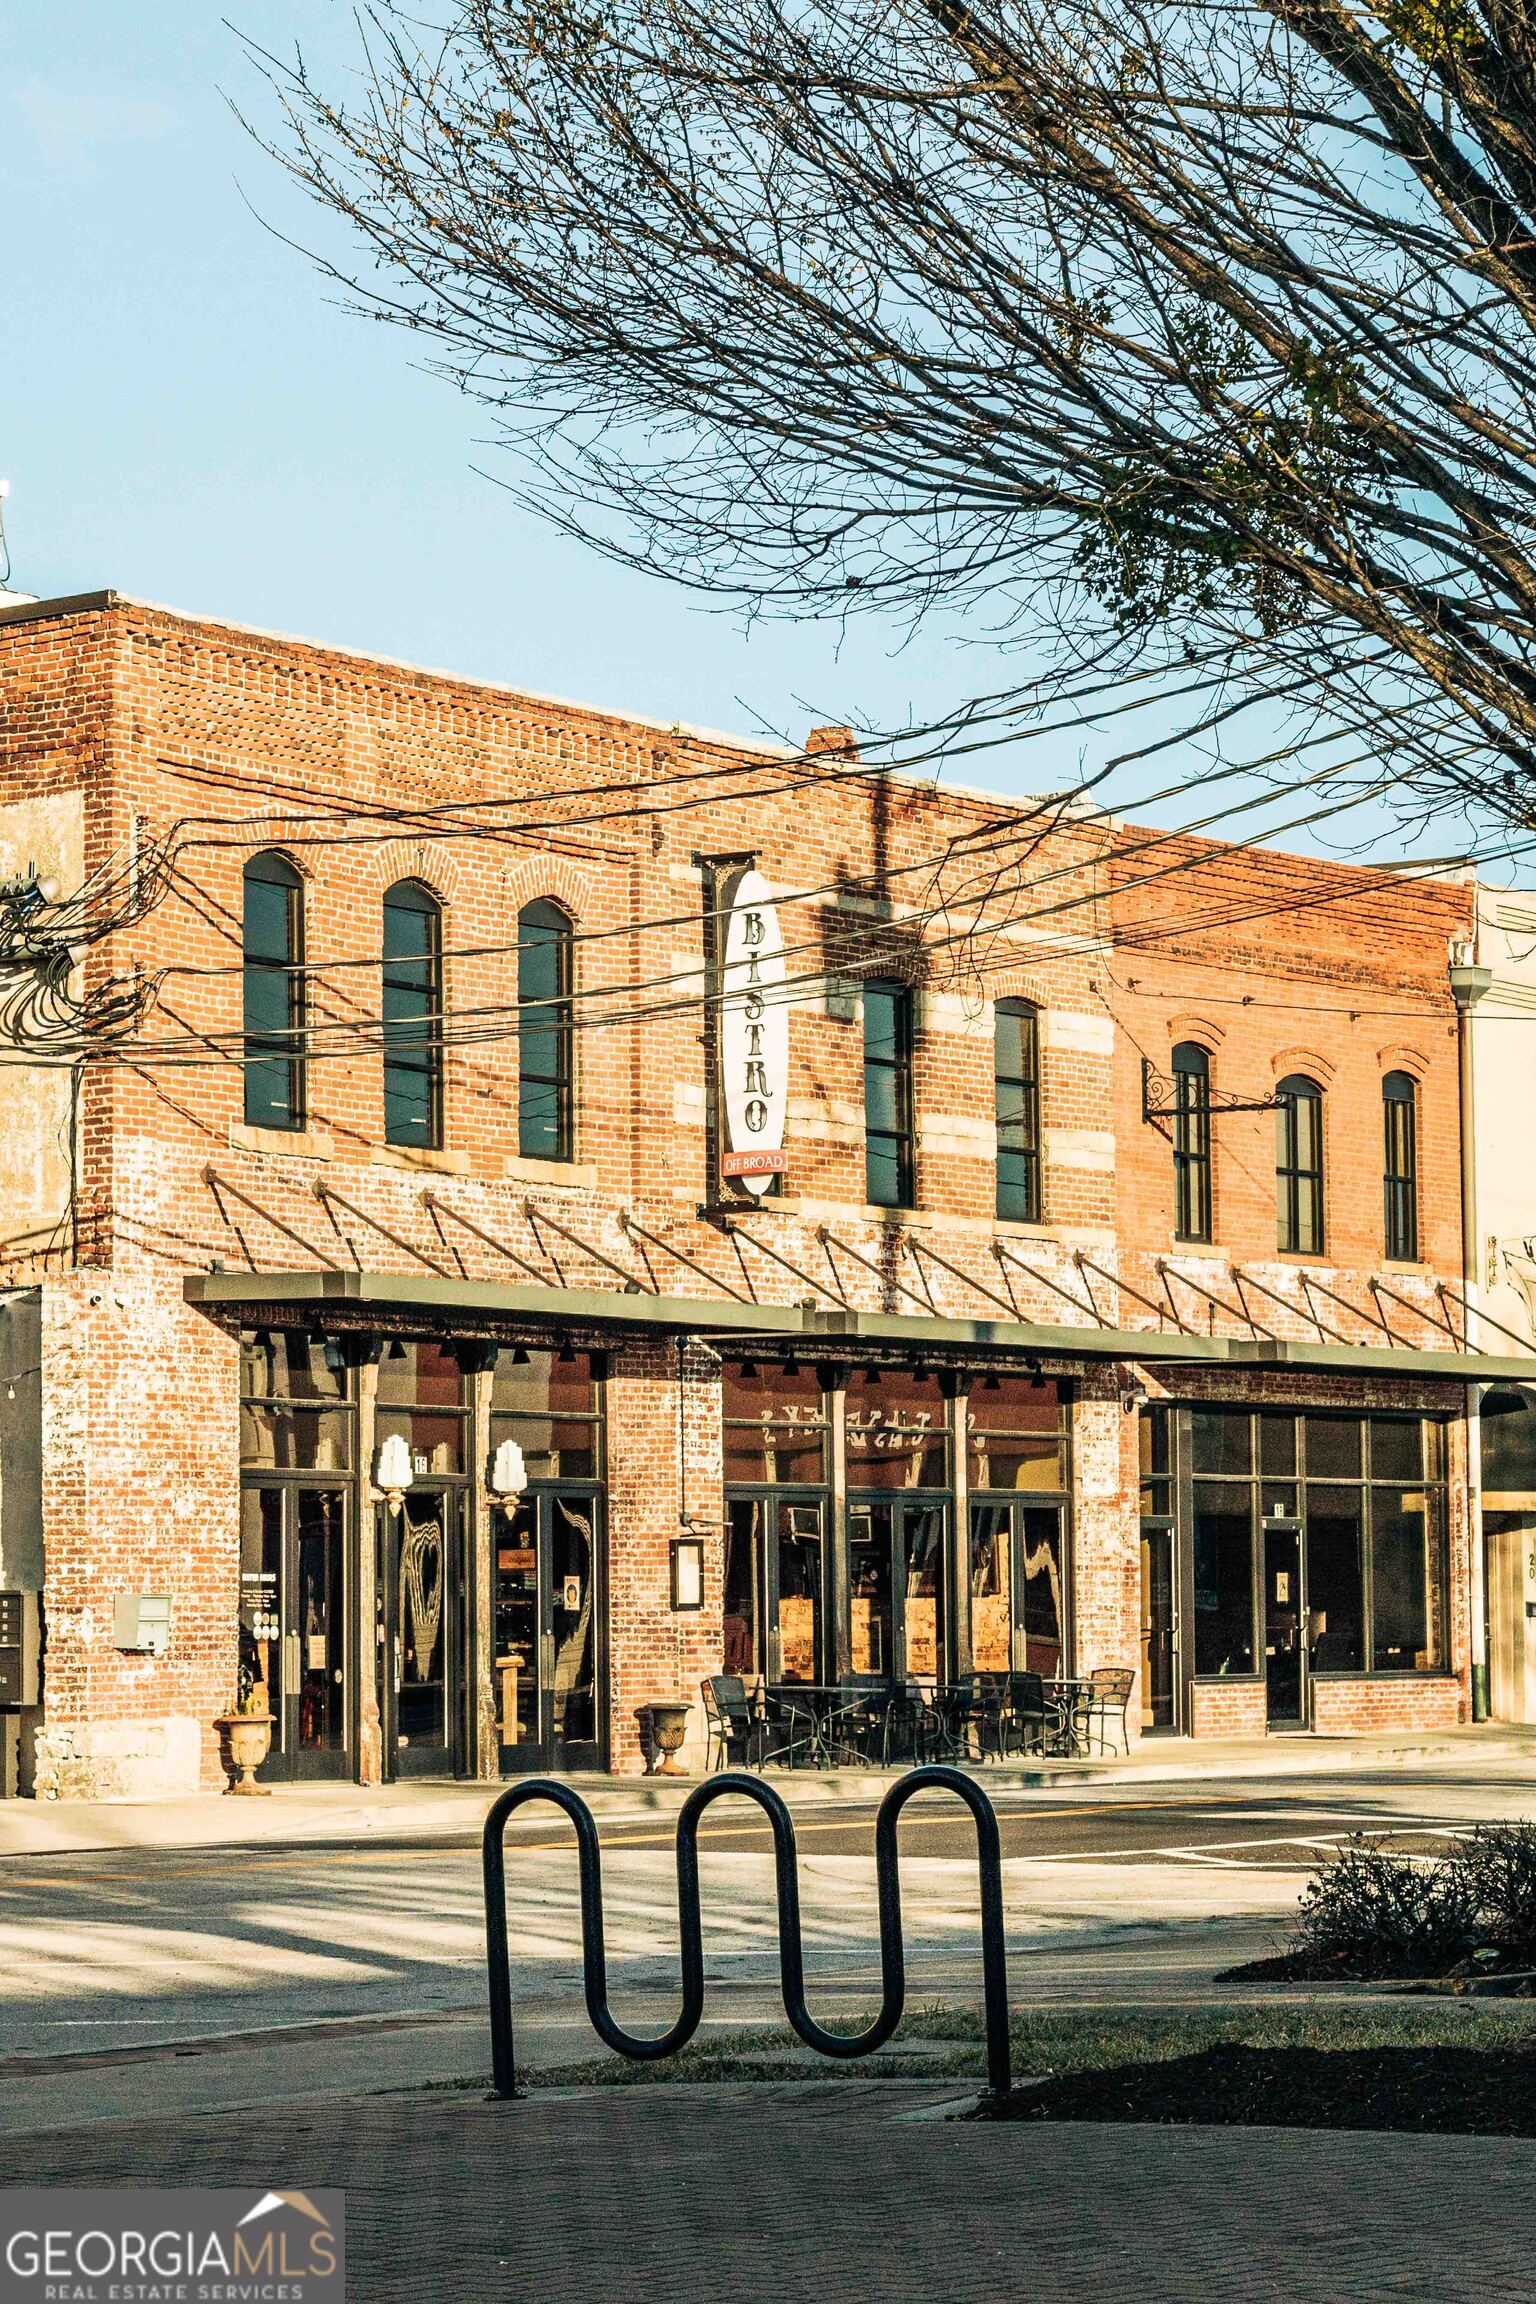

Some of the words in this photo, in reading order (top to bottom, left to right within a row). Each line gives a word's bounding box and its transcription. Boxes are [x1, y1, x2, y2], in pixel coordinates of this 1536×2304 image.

[742, 912, 773, 1133] BISTRO
[725, 1158, 742, 1172] OFF
[743, 1155, 783, 1170] BROAD
